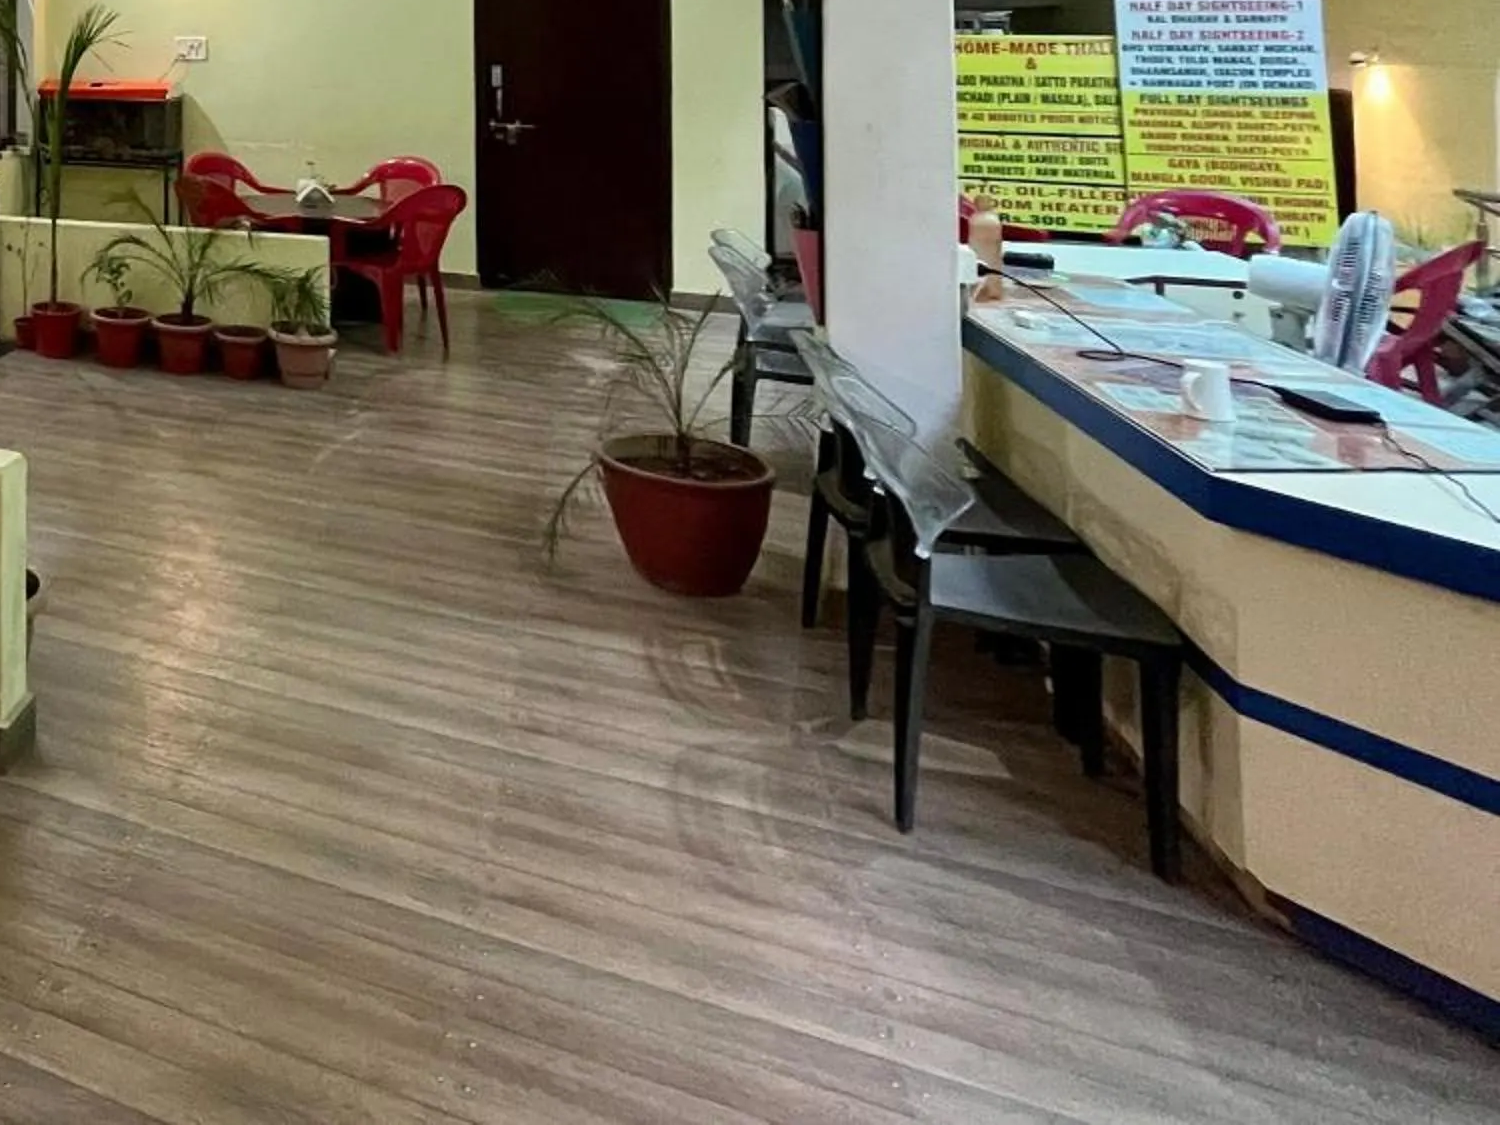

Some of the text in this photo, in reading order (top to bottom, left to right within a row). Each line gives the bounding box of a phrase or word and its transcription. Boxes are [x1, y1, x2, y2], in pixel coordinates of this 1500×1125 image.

[1129, 1, 1303, 12] HALF DAY SIGHTSEEING-1
[1131, 31, 1163, 41] HALF
[1169, 31, 1193, 41] DAY
[1025, 57, 1038, 70] &
[979, 76, 1025, 86] PARATHA
[1139, 94, 1172, 104] FULL
[1176, 94, 1201, 105] DAY
[1167, 158, 1200, 170] GAYA
[988, 198, 1121, 216] OOM HEATER
